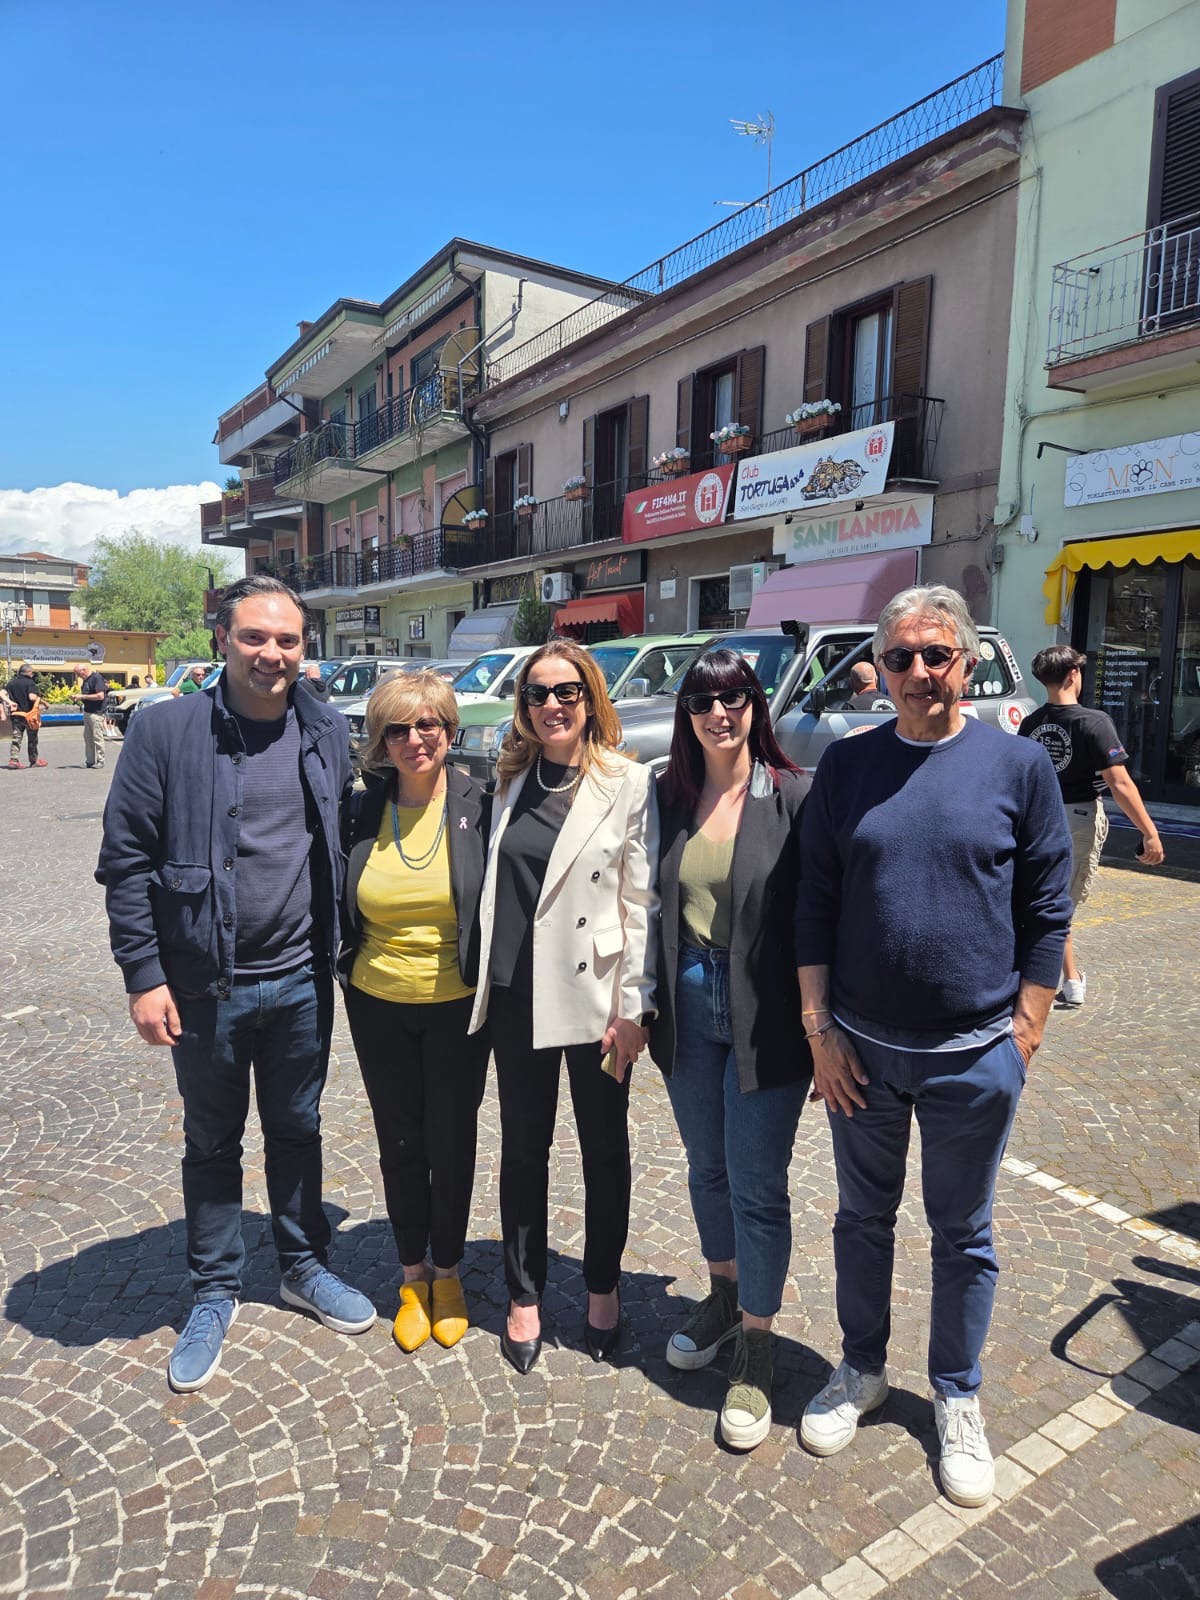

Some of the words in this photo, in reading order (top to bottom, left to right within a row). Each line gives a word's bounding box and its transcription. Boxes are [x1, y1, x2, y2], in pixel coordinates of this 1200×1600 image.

[741, 464, 759, 480] Club
[741, 474, 790, 502] TORTUGA
[793, 504, 923, 549] SANILANDIA
